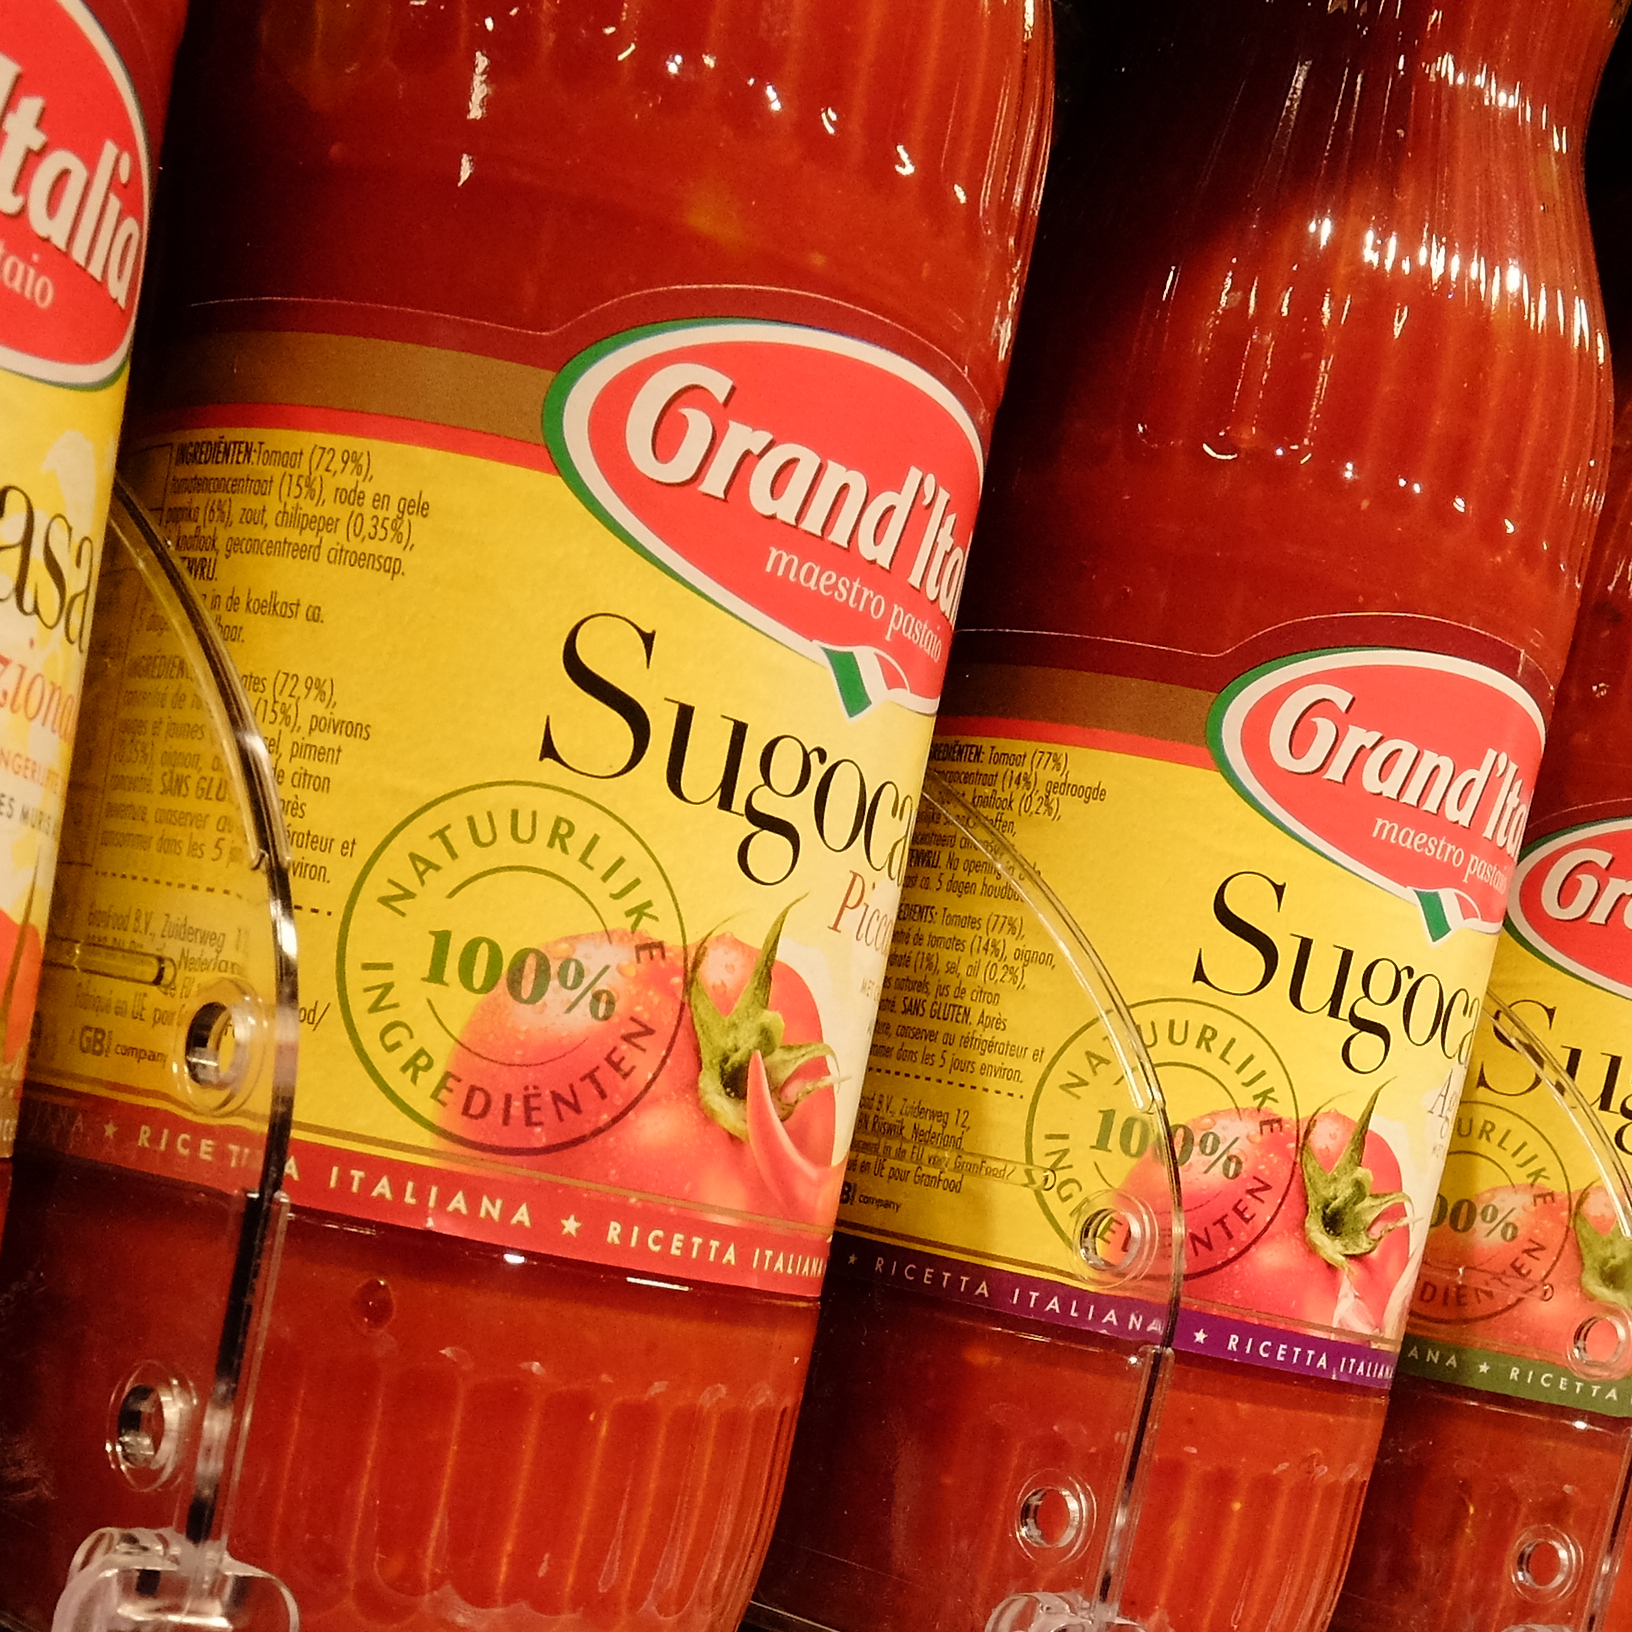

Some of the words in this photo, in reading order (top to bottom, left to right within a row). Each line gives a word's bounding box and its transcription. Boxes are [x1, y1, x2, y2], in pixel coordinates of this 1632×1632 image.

[255, 440, 303, 470] Tomaat
[308, 443, 374, 483] (72,9%),
[278, 472, 326, 508] (15%),
[333, 480, 366, 508] rode
[372, 491, 390, 512] en
[396, 489, 430, 521] gele
[238, 502, 269, 530] zout,
[274, 503, 342, 536] chilipeper
[345, 509, 416, 552] (0,35%),
[224, 533, 324, 562] geconcentreerd
[326, 541, 407, 581] citroensap.
[245, 587, 302, 620] koelkast
[763, 546, 888, 621] maestro
[272, 668, 338, 709] (72,9%),
[308, 711, 373, 742] poivrons
[988, 745, 1027, 769] Tomaat
[1029, 748, 1071, 777] (77%),
[1045, 779, 1107, 804] gedroogde
[1371, 814, 1465, 868] maestro
[376, 805, 670, 964] NATUURLIJKE
[421, 928, 618, 1023] 100%
[1013, 945, 1058, 971] oignon,
[970, 985, 1001, 1007] citron
[976, 1007, 1009, 1032] Après
[358, 960, 659, 1130] INGREDIËNTEN
[958, 1028, 1029, 1060] réfrigérateur
[979, 1058, 1024, 1084] environ.
[328, 1163, 536, 1230] ITALIANA
[605, 1219, 739, 1269] RICETTA
[874, 1255, 993, 1299] RICETTA
[1226, 1333, 1332, 1374] RICETTA
[1508, 1365, 1620, 1403] RICETTA
